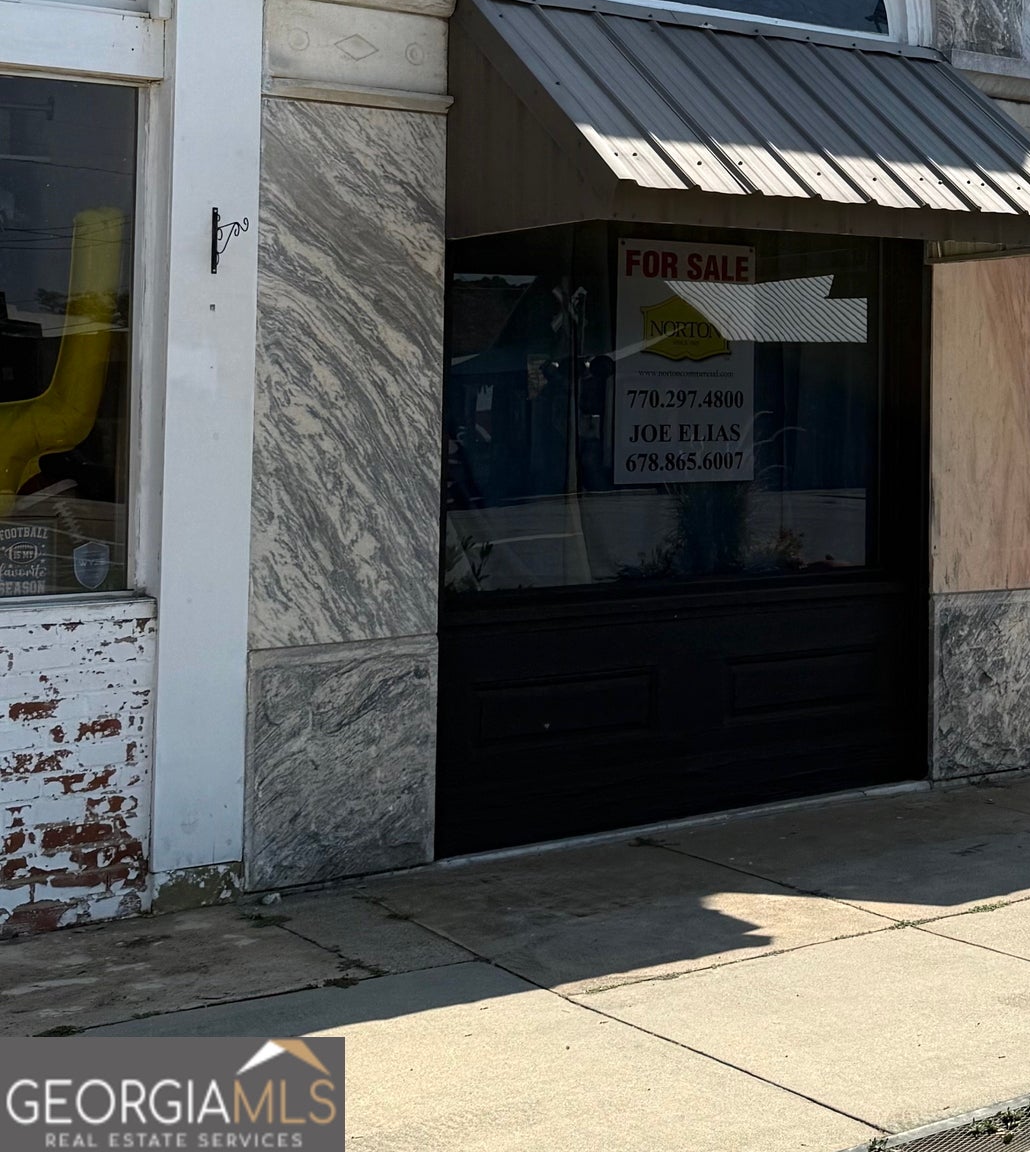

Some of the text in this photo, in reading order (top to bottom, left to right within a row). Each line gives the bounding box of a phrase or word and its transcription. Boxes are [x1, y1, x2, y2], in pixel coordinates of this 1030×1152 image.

[625, 249, 749, 282] FOR SALE
[626, 389, 744, 409] 770.297.4800
[629, 423, 741, 442] JOE ELIAS
[625, 452, 744, 472] 678.865.6007
